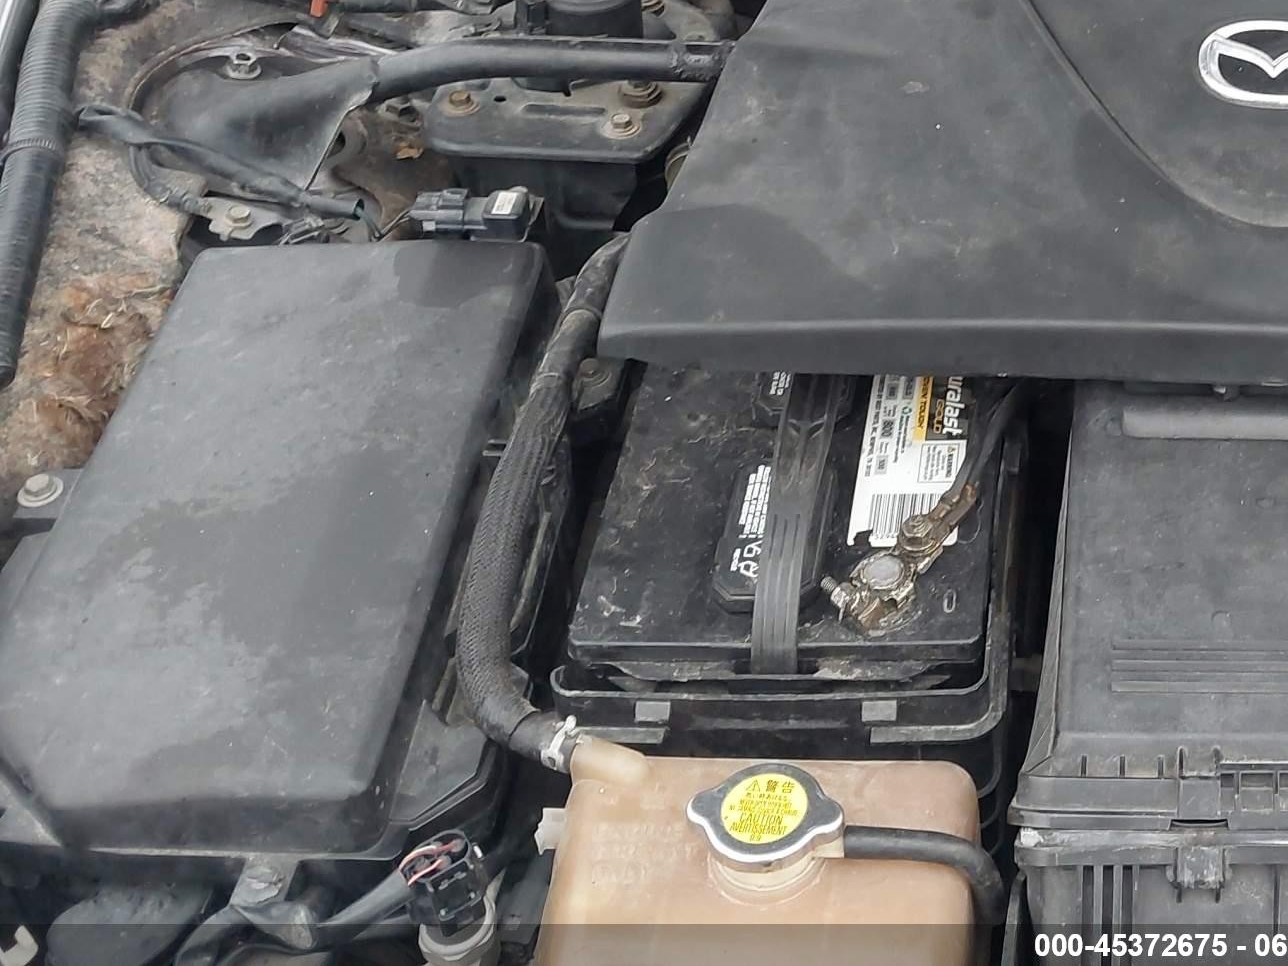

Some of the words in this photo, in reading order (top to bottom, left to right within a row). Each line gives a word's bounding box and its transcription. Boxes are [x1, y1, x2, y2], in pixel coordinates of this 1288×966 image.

[918, 401, 927, 429] TOUGH
[934, 398, 945, 434] GOLD
[942, 376, 965, 436] uralast
[881, 419, 894, 438] 800
[729, 822, 788, 835] AVERTISSEMENT
[740, 812, 784, 825] CAUTION
